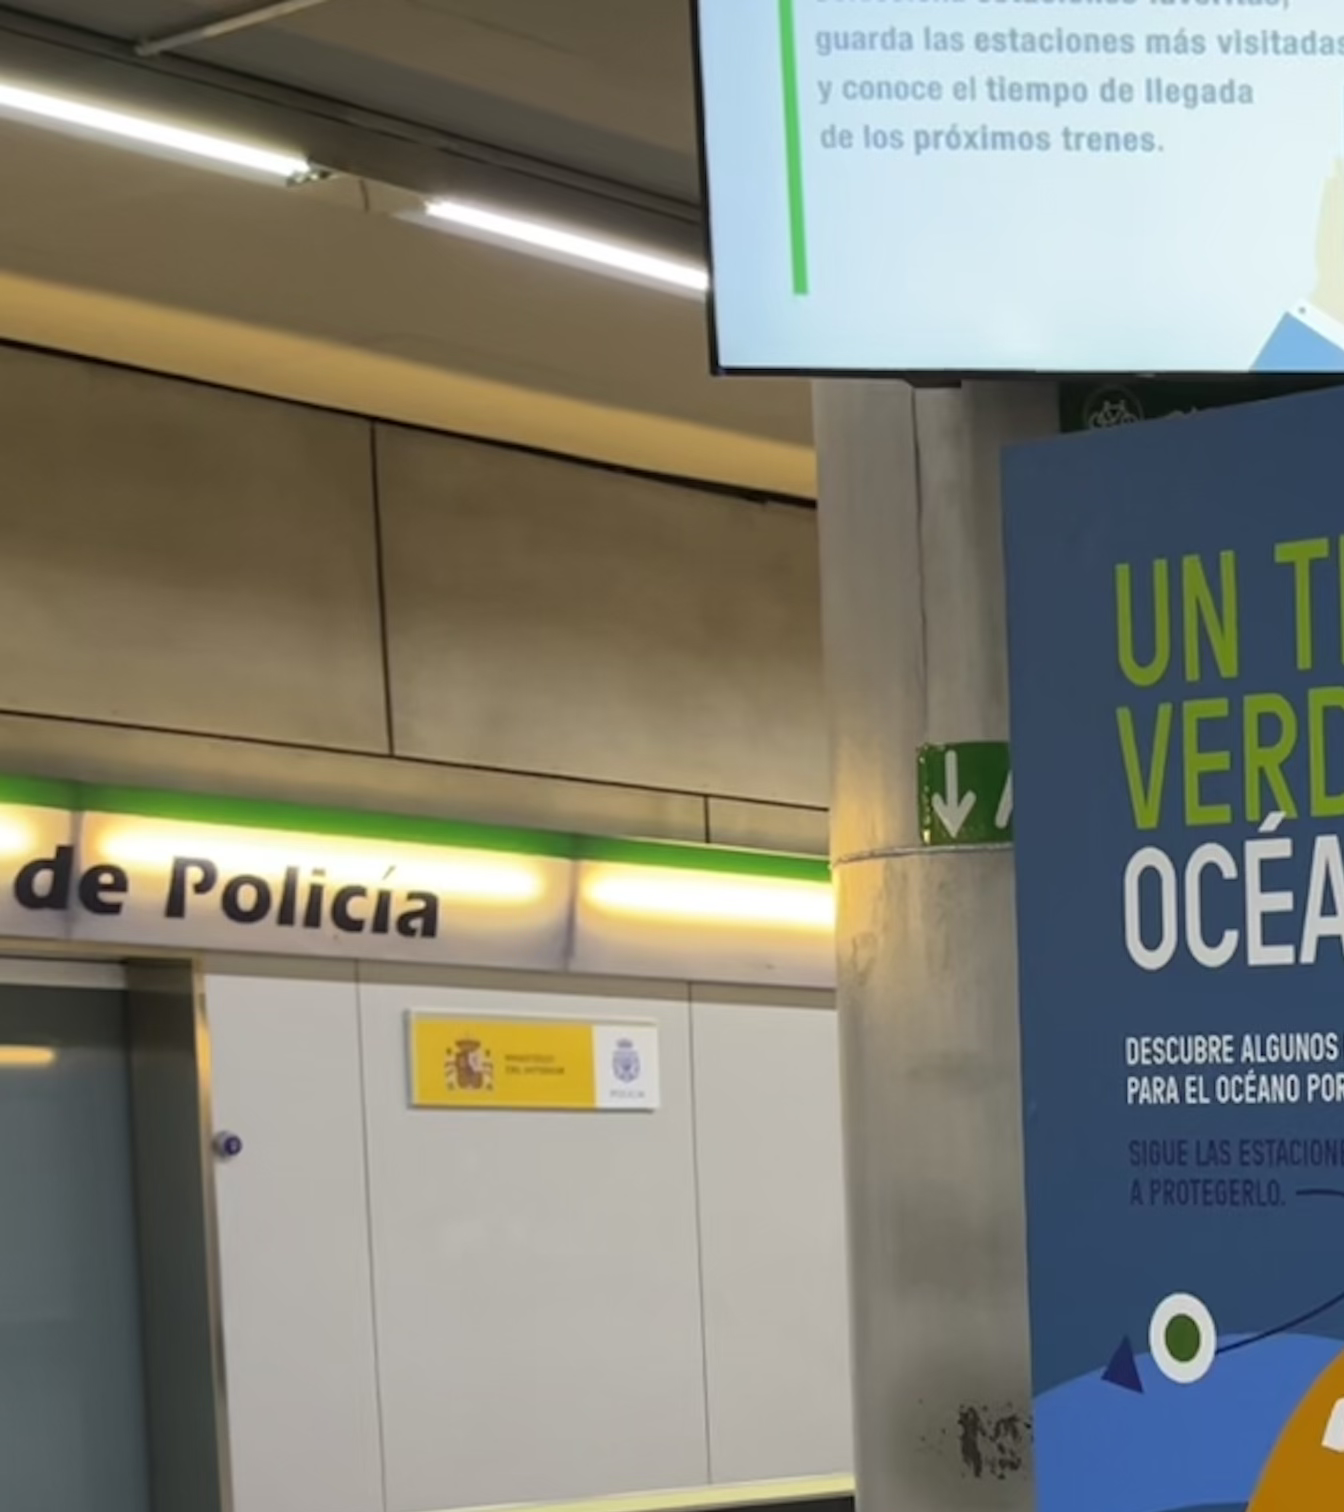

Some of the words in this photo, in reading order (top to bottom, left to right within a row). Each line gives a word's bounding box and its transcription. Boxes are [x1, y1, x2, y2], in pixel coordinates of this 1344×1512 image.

[815, 26, 914, 56] guarda
[924, 25, 965, 52] las
[973, 27, 1135, 54] estaciones
[1145, 28, 1206, 54] más
[817, 79, 833, 104] y
[842, 78, 943, 102] conoce
[952, 75, 977, 102] el
[987, 76, 1089, 108] tiempo
[1099, 77, 1135, 104] de
[1145, 77, 1255, 109] llegada
[820, 124, 854, 150] de
[864, 124, 905, 150] los
[913, 124, 1052, 157] próximos
[1062, 126, 1164, 153] trenes.
[1115, 550, 1238, 688] UN
[14, 845, 130, 916] de
[165, 855, 441, 940] Policía
[1125, 1034, 1235, 1066] DESCUBRE
[1240, 1032, 1338, 1064] ALGUNOS
[1126, 1075, 1180, 1105] PARA
[1185, 1074, 1210, 1104] EL
[1215, 1069, 1301, 1105] OCÉANO
[1129, 1139, 1188, 1168] SIGUE
[1195, 1138, 1232, 1167] LAS
[1130, 1178, 1143, 1206] A
[1150, 1177, 1286, 1207] PROTEGERLO.
